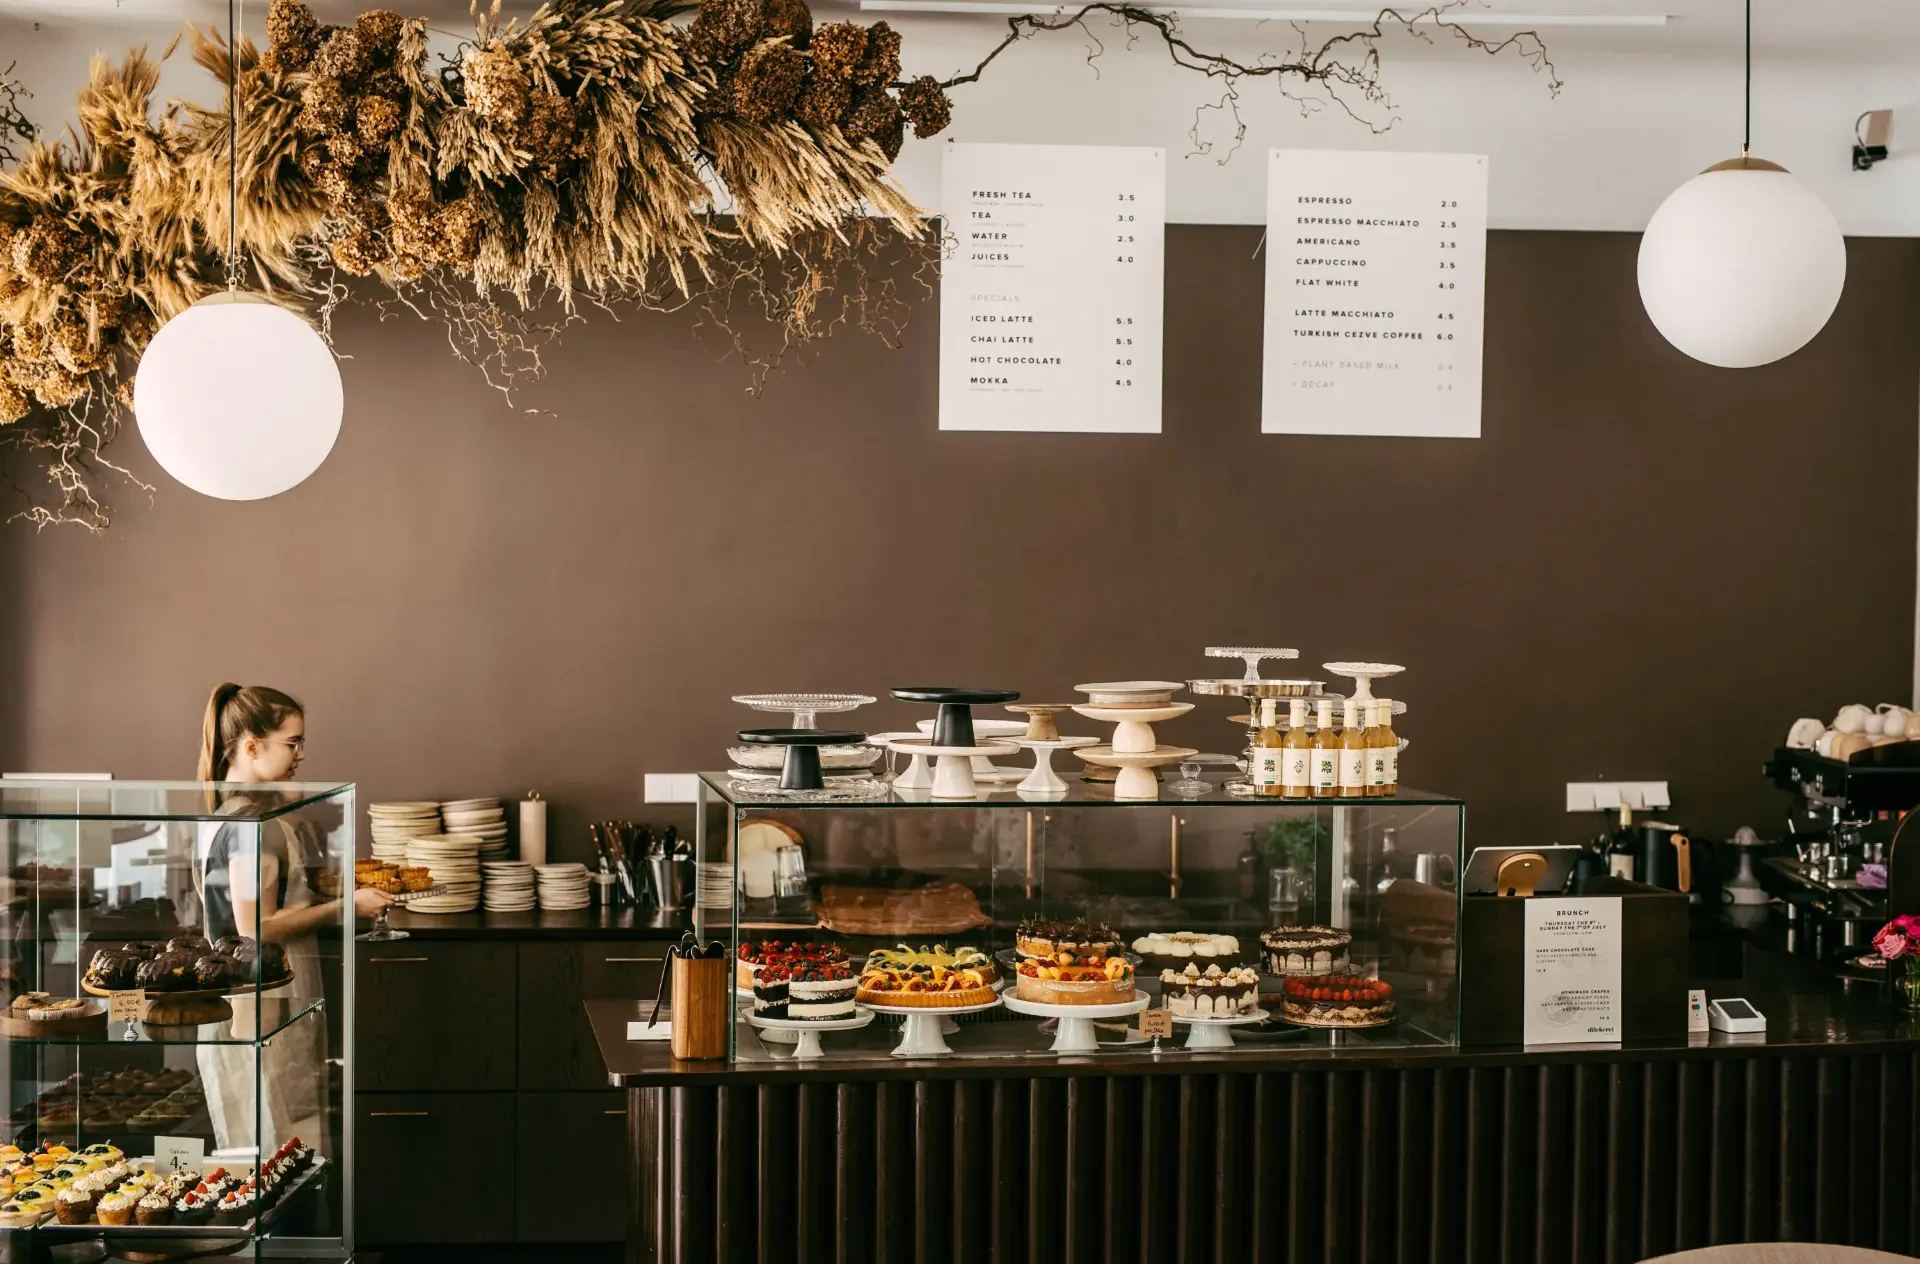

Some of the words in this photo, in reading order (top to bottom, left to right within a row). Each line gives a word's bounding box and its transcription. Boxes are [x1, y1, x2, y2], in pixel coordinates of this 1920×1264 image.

[972, 190, 1007, 199] FRESH
[1012, 191, 1032, 199] TEA
[1118, 194, 1135, 202] 3.5
[1297, 196, 1353, 205] ESPRESSO
[1441, 200, 1457, 208] 2.0
[971, 211, 991, 219] TEA
[1118, 214, 1135, 222] 3.0
[1297, 217, 1352, 226] ESPRESSO
[1356, 219, 1420, 227] MACCHIATO
[1440, 221, 1457, 229] 2.5
[971, 232, 1008, 240] WATER
[1117, 235, 1134, 243] 2.5
[1296, 237, 1360, 246] AMERICANO
[1440, 241, 1456, 249] 3.5
[971, 253, 1009, 261] JUICES
[1296, 258, 1367, 267] CAPPUCCINO
[1295, 278, 1321, 286] FLAT
[1325, 279, 1359, 287] WHITE
[1438, 282, 1455, 290] 4.0
[971, 294, 1020, 302] SPECIALS
[1294, 309, 1326, 317] LATTE
[1331, 310, 1394, 319] MACCHIATO
[971, 315, 996, 323] ICED
[1001, 315, 1033, 323] LATTE
[1116, 317, 1133, 325] 5.5
[970, 335, 997, 343] CHAI
[1002, 336, 1034, 344] LATTE
[1115, 338, 1133, 346] 5.5
[1294, 329, 1340, 338] TURKISH
[1344, 331, 1377, 339] CEZVE
[1382, 332, 1423, 340] COFFEE
[1436, 333, 1454, 341] 6.0
[970, 356, 992, 364] HOT
[996, 356, 1061, 365] CHOCOLATE
[1115, 358, 1132, 366] 4.0
[1302, 360, 1335, 369] PLANT
[1339, 361, 1372, 370] BASED
[1376, 362, 1401, 370] MILK
[1437, 363, 1453, 371] 04
[1115, 379, 1132, 387] 4.5
[1437, 383, 1453, 392] 04
